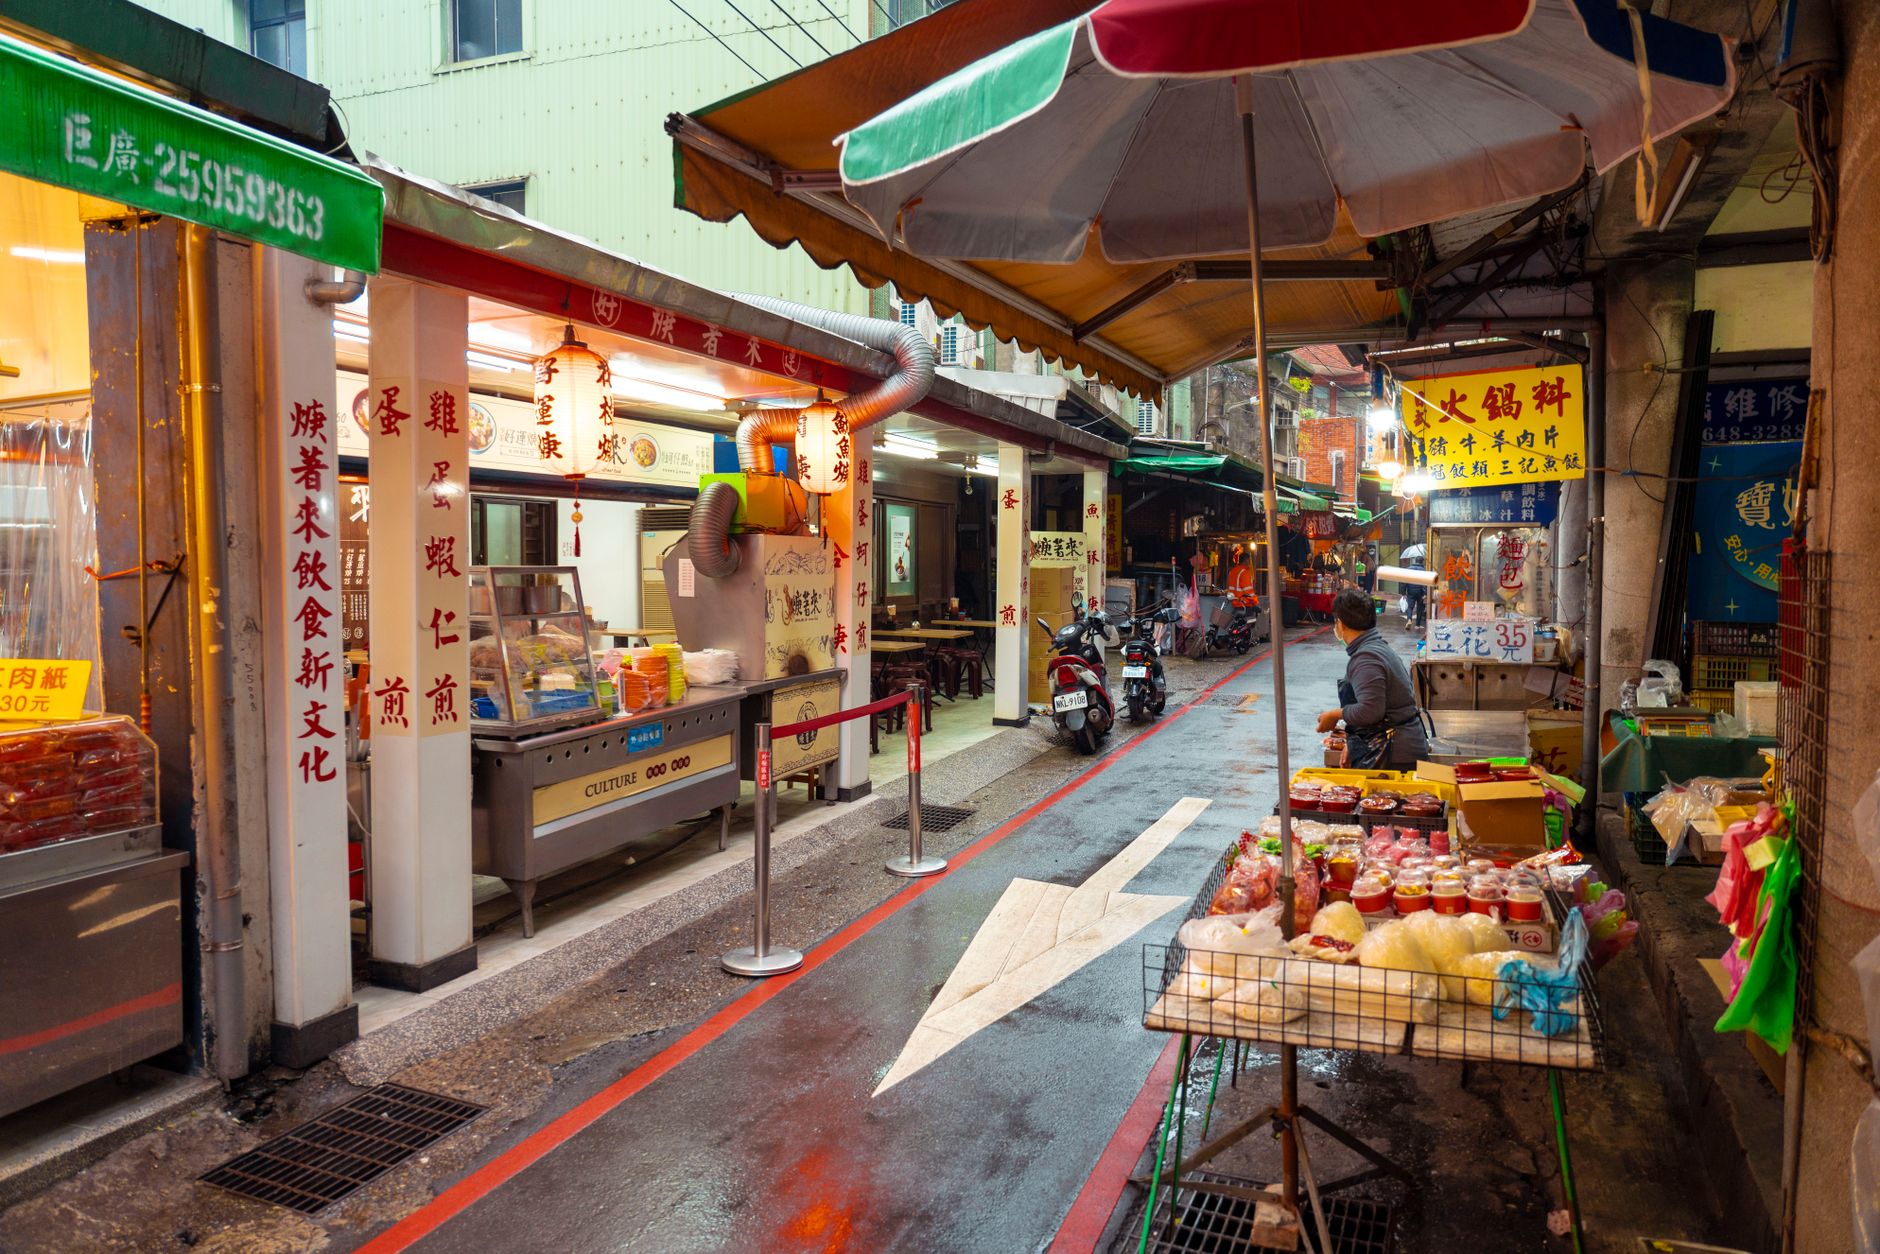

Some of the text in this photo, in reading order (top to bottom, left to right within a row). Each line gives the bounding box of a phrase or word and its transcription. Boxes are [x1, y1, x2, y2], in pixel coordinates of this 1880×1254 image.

[1438, 376, 1572, 425] 火鍋料
[424, 390, 462, 726] 雞蛋蝦仁煎
[1497, 533, 1524, 590] 麵包
[1431, 623, 1528, 657] 豆花 35
[585, 771, 638, 798] CULTURE
